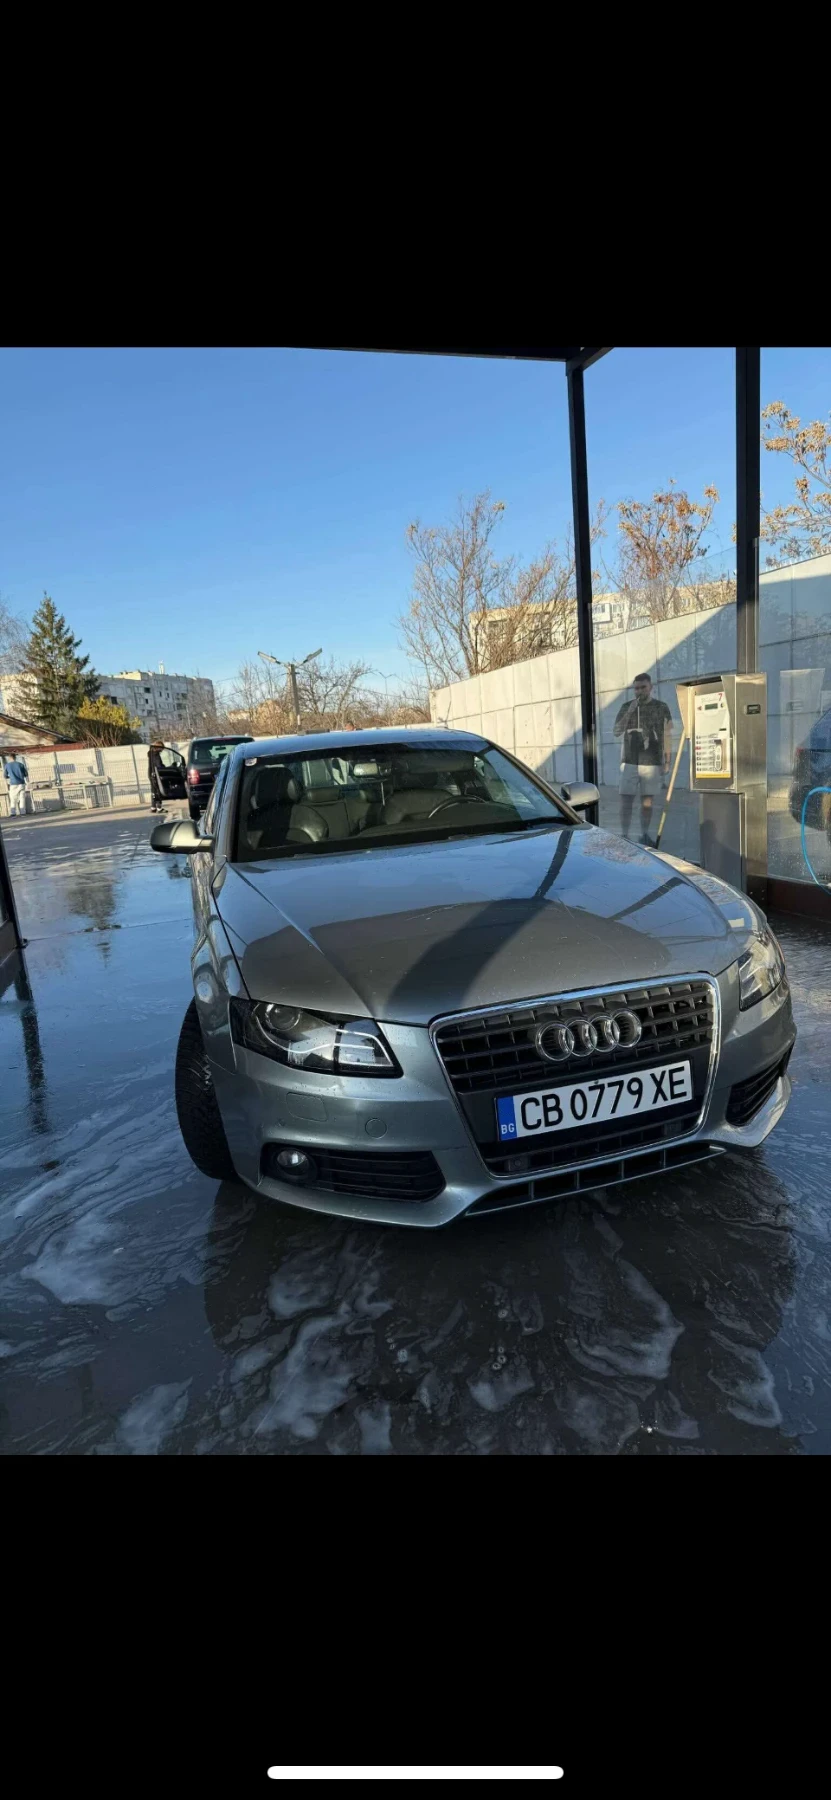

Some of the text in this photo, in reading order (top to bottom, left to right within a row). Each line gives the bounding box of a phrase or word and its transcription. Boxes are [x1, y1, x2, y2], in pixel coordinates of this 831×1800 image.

[520, 1066, 687, 1130] CB 0779 XE
[501, 1123, 515, 1135] BG
